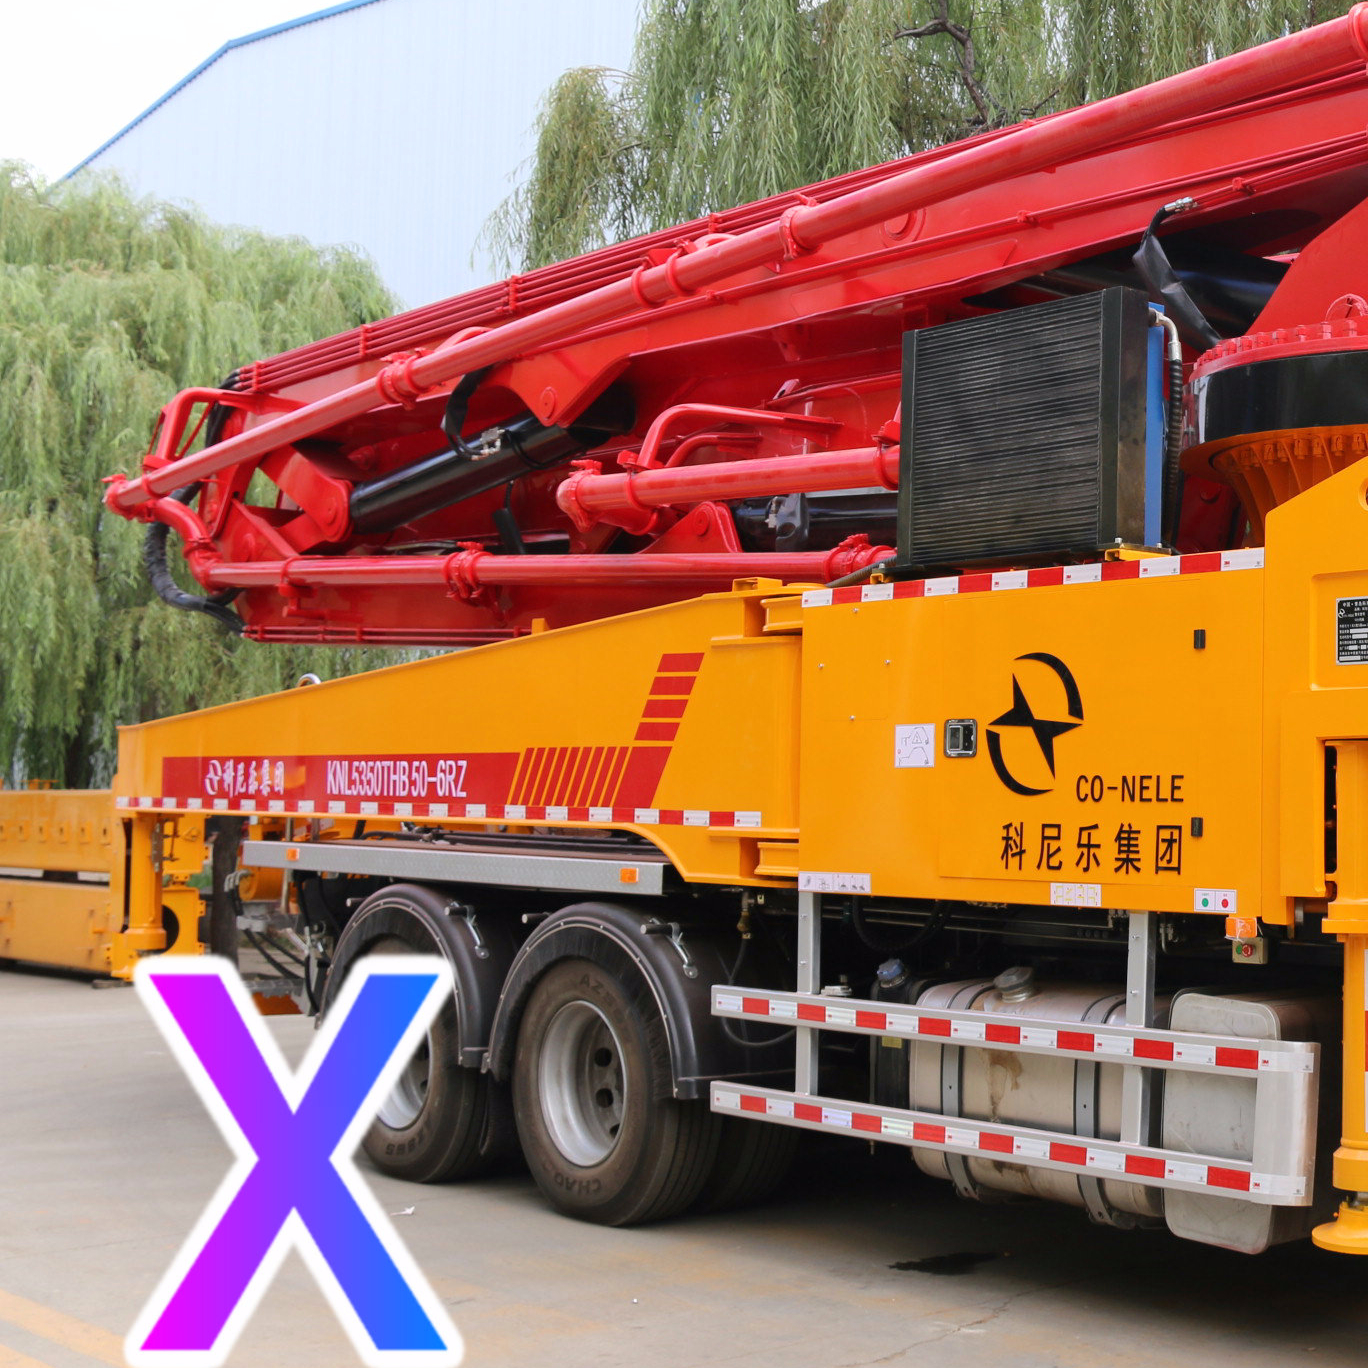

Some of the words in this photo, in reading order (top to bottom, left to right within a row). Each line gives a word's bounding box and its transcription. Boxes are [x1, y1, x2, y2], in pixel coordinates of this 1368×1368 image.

[222, 759, 285, 798] 科尼乐集团
[1076, 775, 1185, 803] CO-NELE
[1000, 821, 1183, 876] 科尼乐集团
